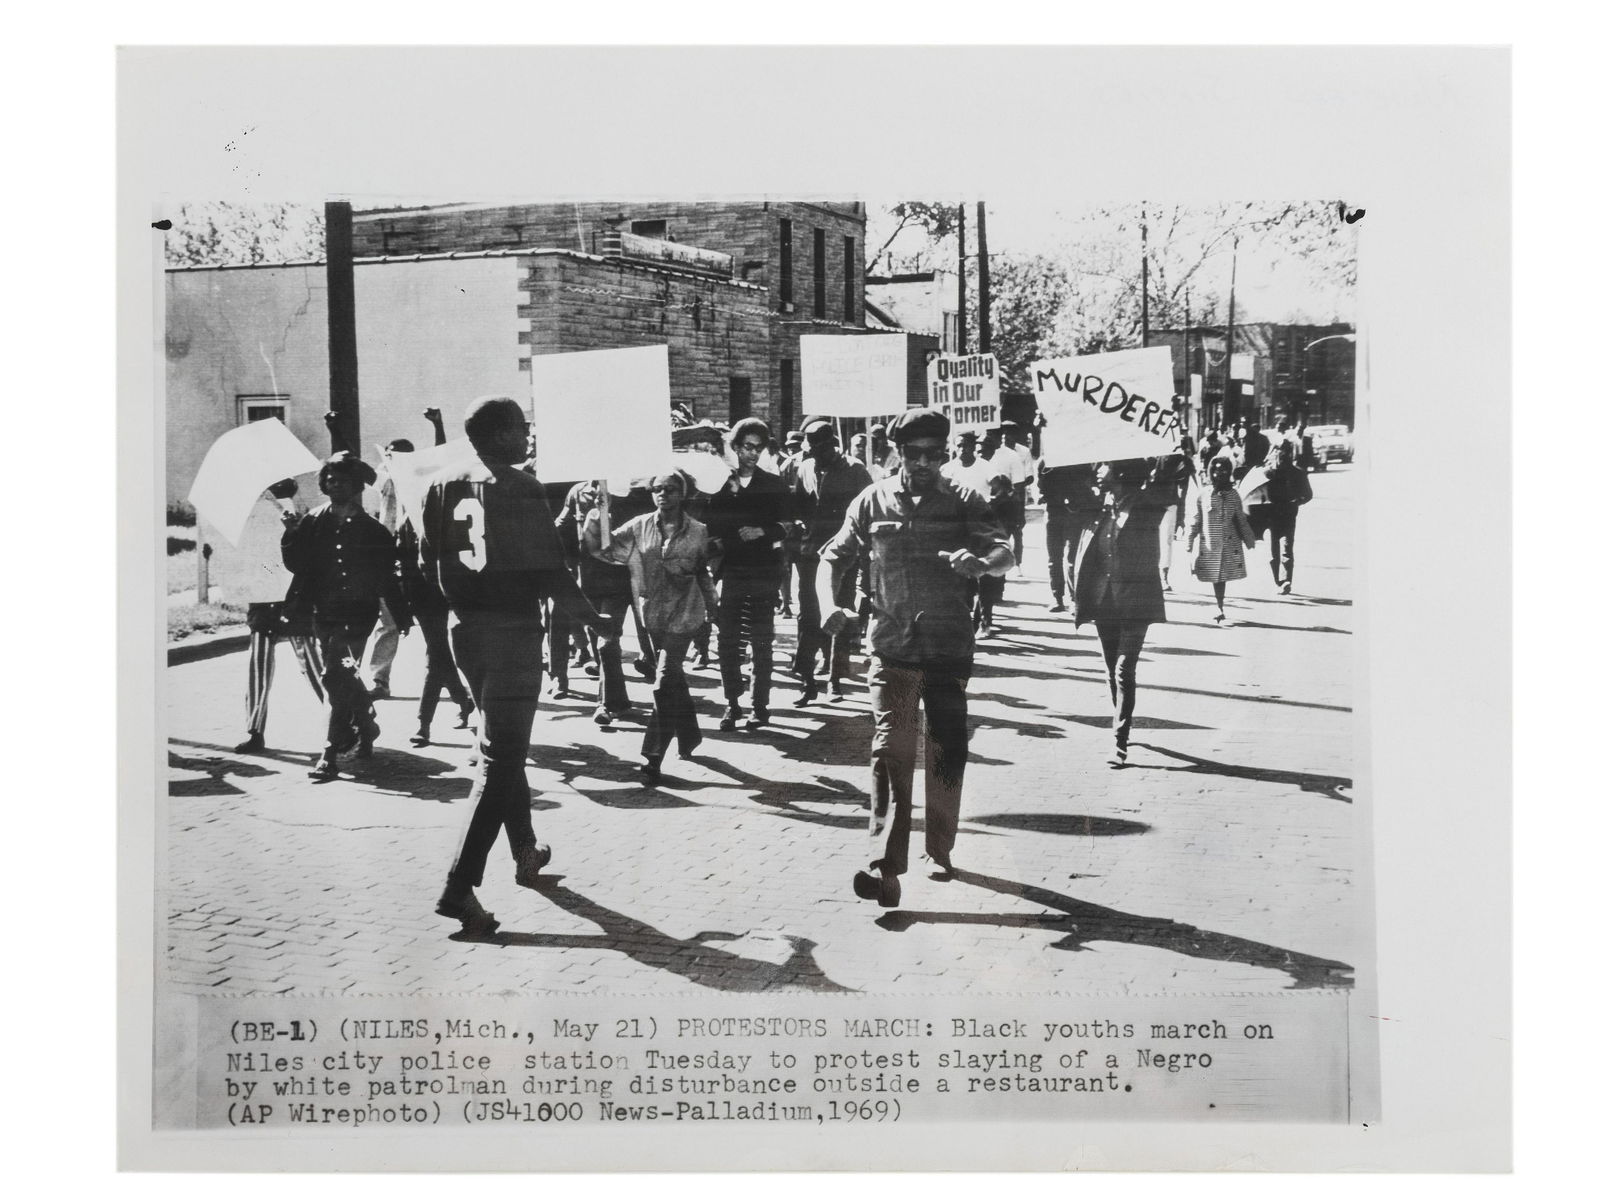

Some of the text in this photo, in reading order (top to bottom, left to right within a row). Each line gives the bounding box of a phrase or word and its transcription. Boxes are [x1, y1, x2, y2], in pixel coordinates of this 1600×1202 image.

[937, 356, 994, 382] Quality
[932, 381, 983, 403] in Our
[1036, 368, 1181, 442] MURDERER
[453, 498, 487, 573] 3
[230, 1016, 1275, 1045] (BE-1) (NILES,Mich., May 21) PROTESTORS MARCH: Black youths march on
[226, 1049, 1213, 1075] Niles city police station Tuesday to protest slaying of a Negro
[225, 1071, 1134, 1100] by white patrolman during disturbance outside a restaurant.
[228, 1102, 273, 1126] (AP
[288, 1101, 441, 1127] Wirephoto)
[599, 1098, 901, 1126] News-Palladium,1969)
